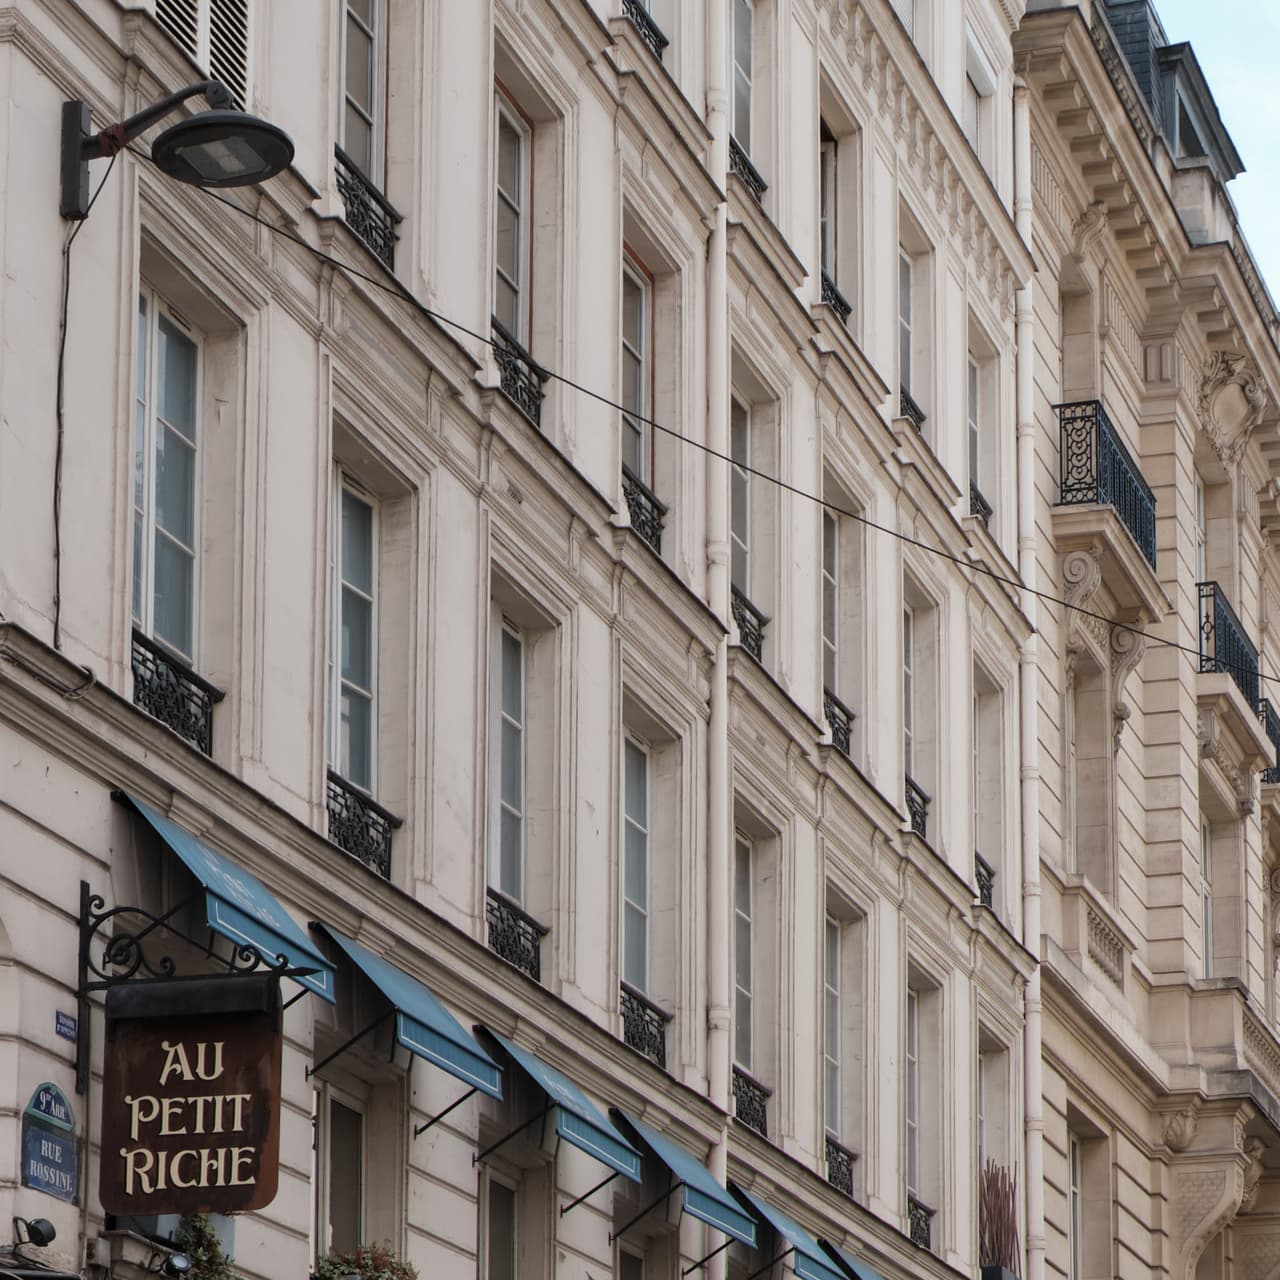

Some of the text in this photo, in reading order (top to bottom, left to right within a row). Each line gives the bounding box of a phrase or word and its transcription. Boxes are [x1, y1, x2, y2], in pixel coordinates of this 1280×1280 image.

[160, 1040, 225, 1087] AU
[124, 1093, 252, 1142] PETIT
[41, 1139, 62, 1163] RUE
[120, 1146, 256, 1196] RICHE
